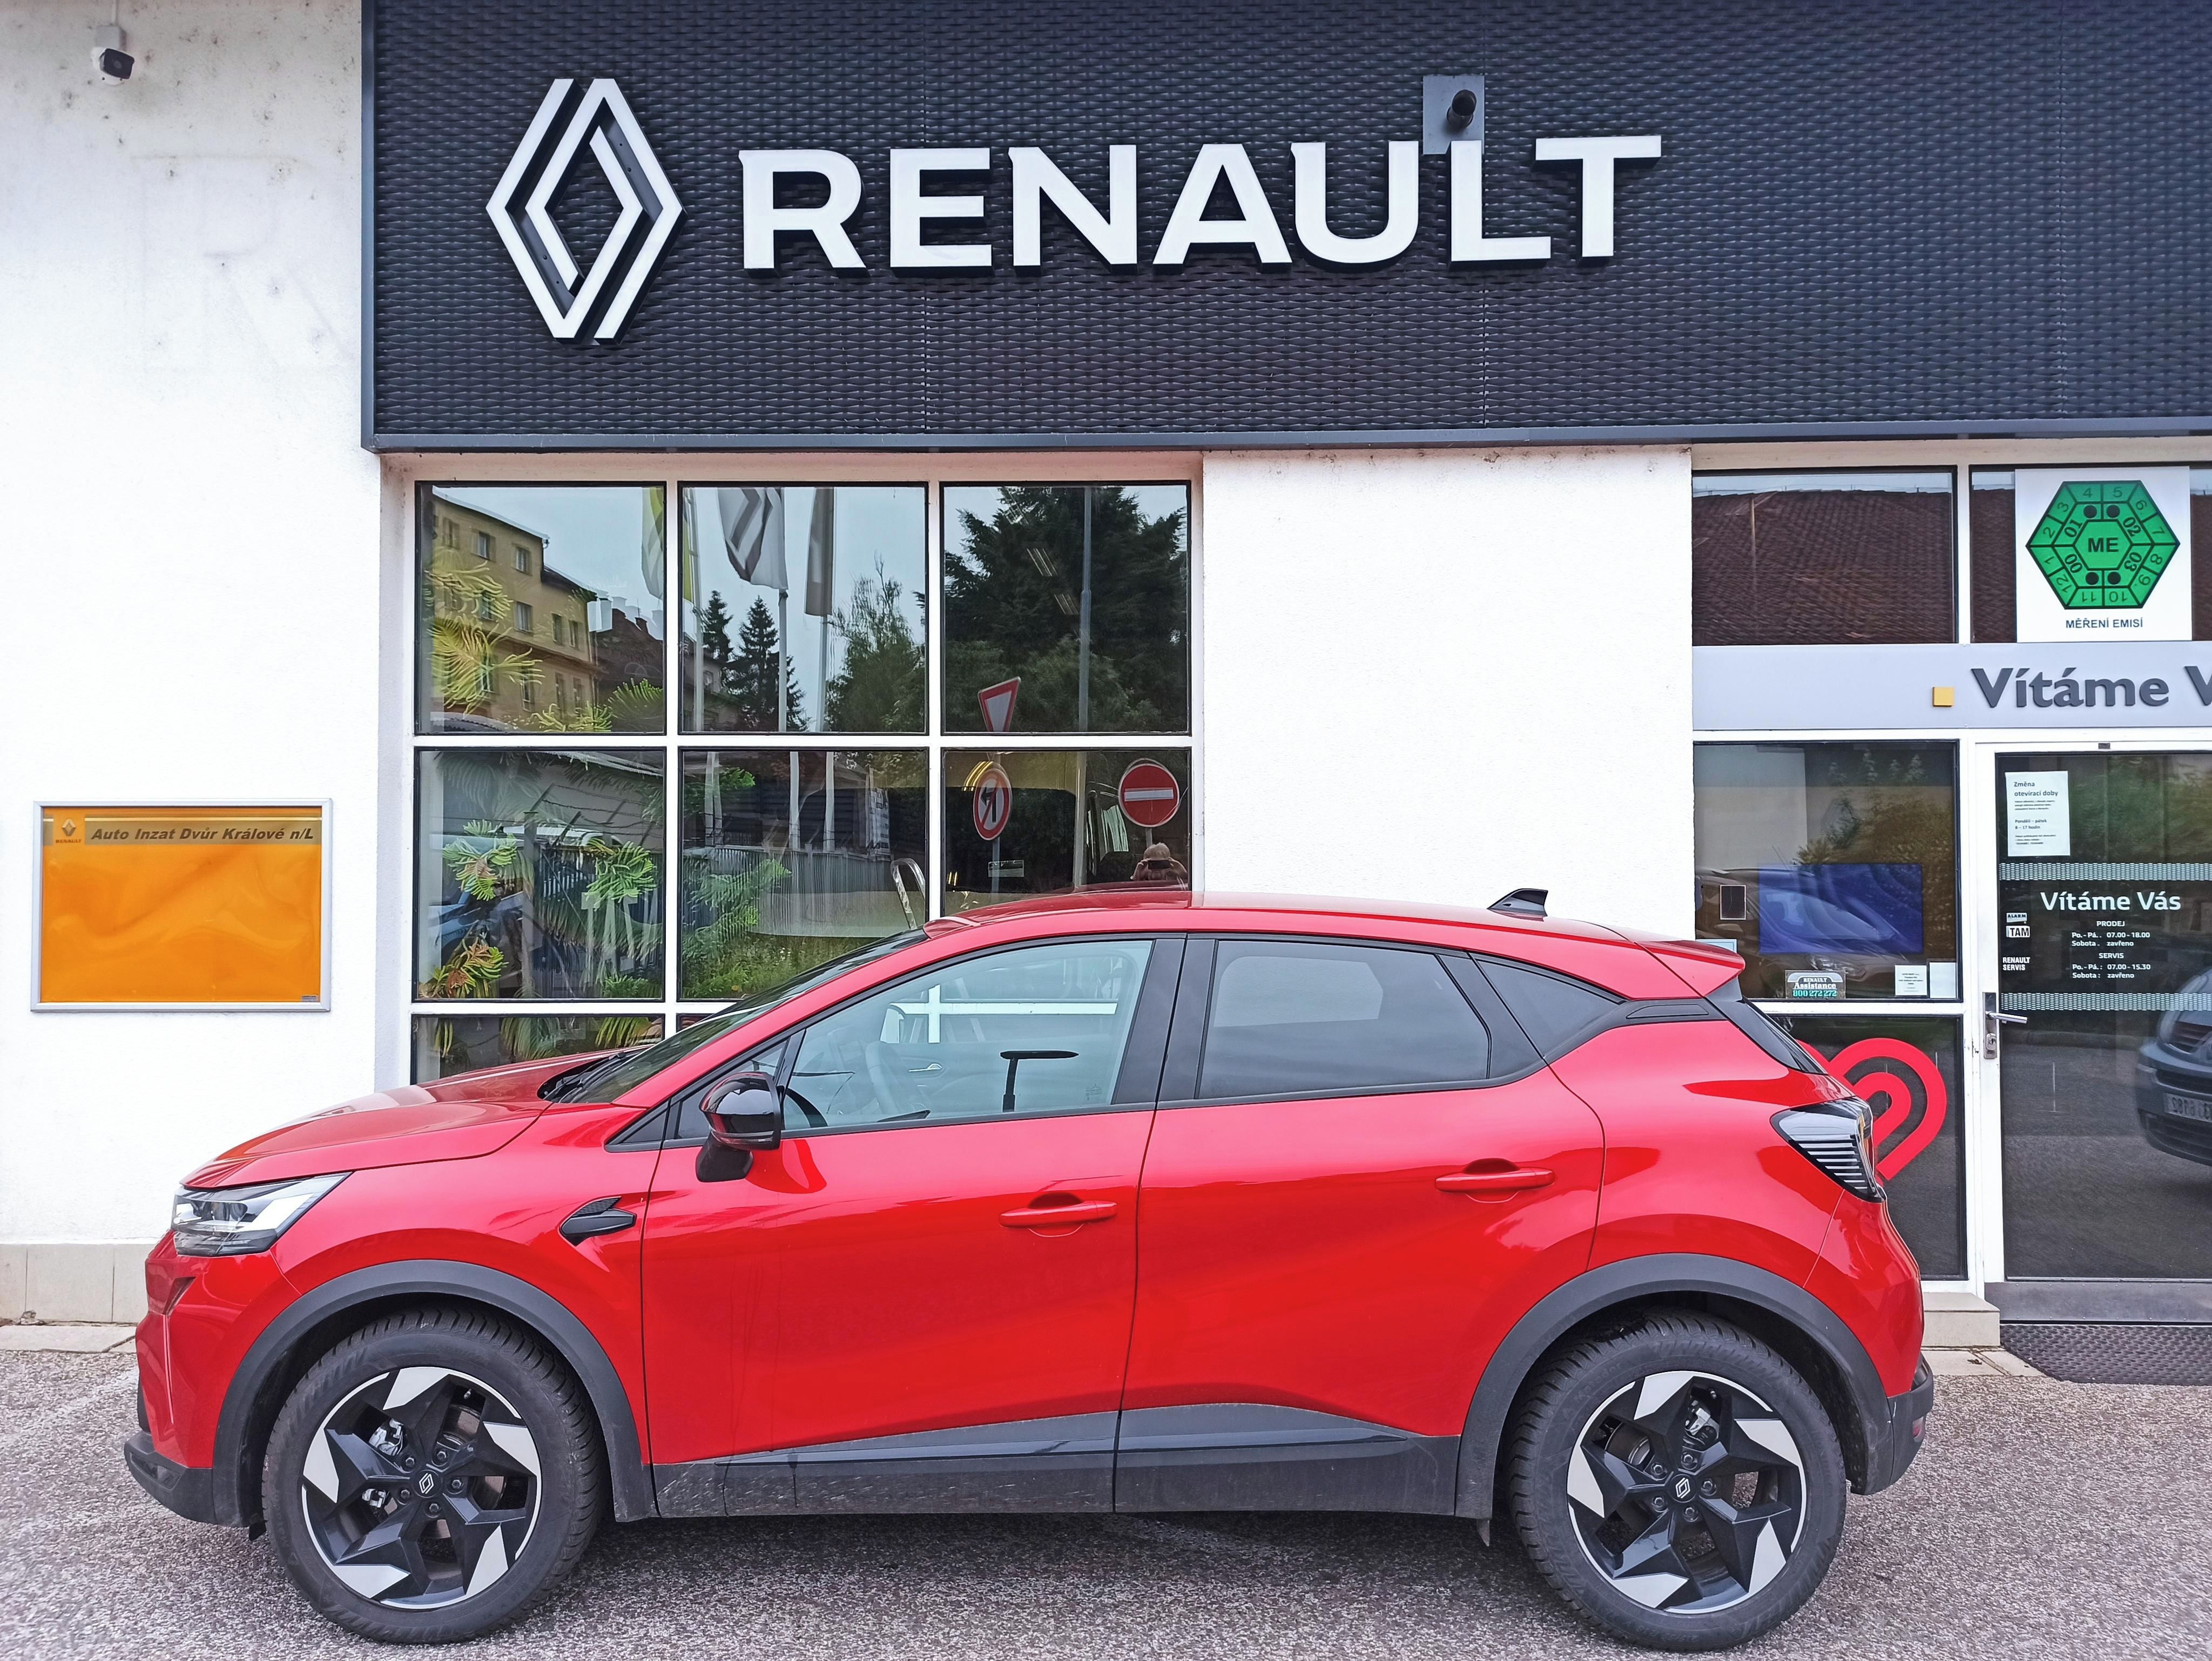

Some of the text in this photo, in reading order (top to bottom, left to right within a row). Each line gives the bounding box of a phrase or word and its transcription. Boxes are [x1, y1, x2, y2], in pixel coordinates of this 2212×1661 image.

[739, 135, 1662, 269] RENAULT
[2083, 488, 2092, 498] 4
[2113, 487, 2123, 498] 5
[2057, 502, 2069, 512] 3
[2043, 526, 2055, 538] 2
[2064, 518, 2083, 538] 01
[2122, 517, 2141, 537] 02
[2152, 527, 2165, 535] 7
[2088, 537, 2119, 552] ME
[2044, 556, 2055, 564] 1
[2064, 553, 2083, 573] 00
[2124, 552, 2142, 572] 03
[2150, 553, 2163, 565] 8
[2056, 573, 2072, 593] 12
[2081, 591, 2097, 602] 11
[2109, 591, 2128, 603] 10
[2066, 617, 2143, 629] MĚŘENÍ EMISÍ
[1971, 667, 2169, 708] Vítáme
[91, 827, 314, 840] Auto Inzat Dvůr Králové n/L
[2040, 891, 2181, 910] Vítáme Vás
[2009, 928, 2029, 937] TAM
